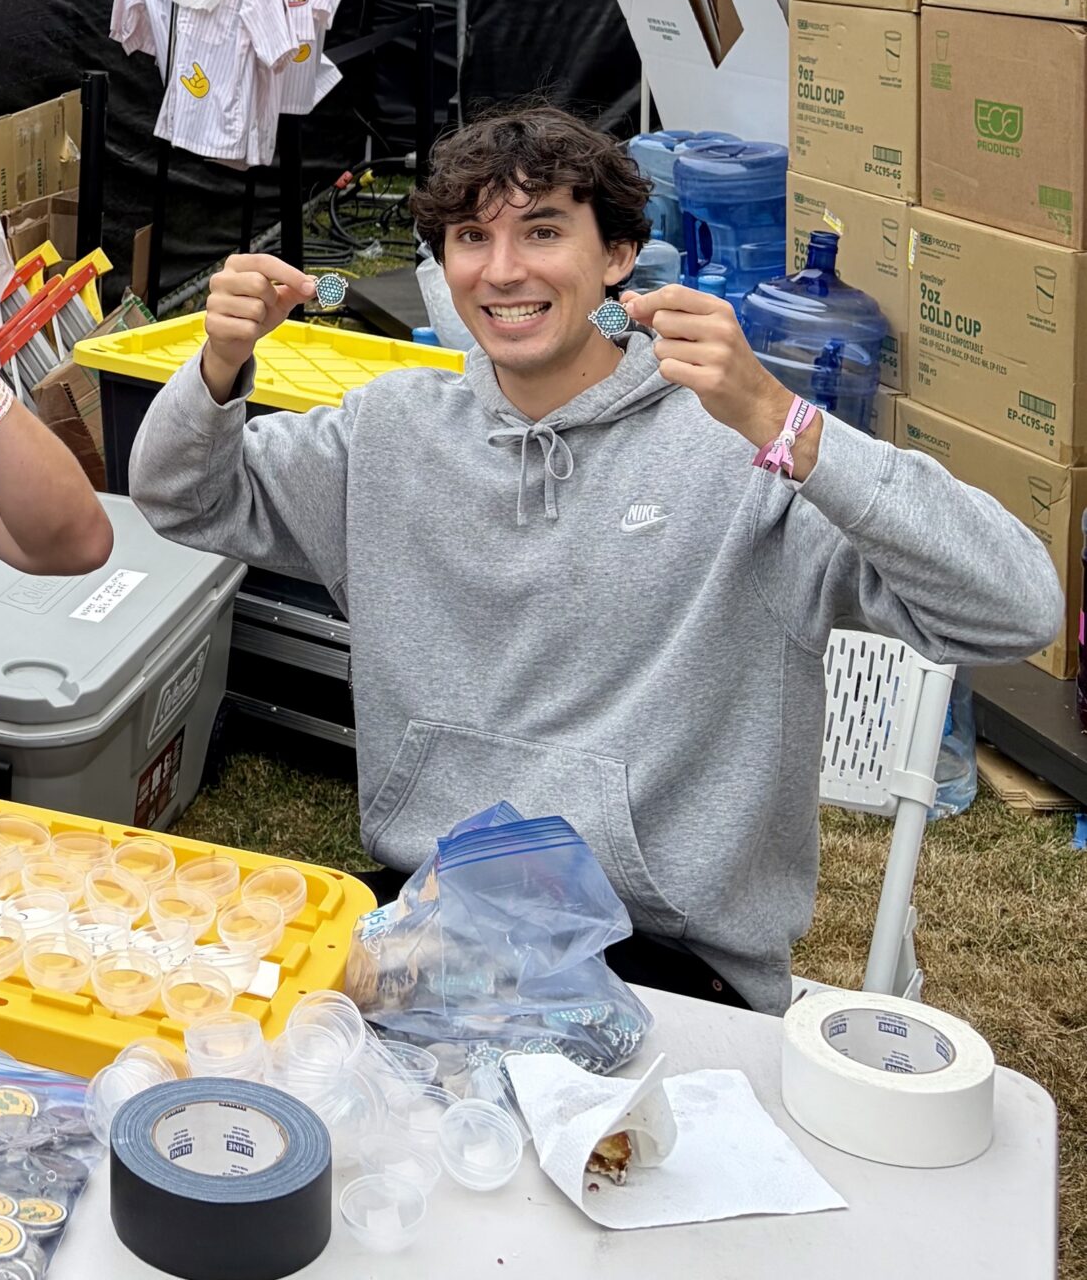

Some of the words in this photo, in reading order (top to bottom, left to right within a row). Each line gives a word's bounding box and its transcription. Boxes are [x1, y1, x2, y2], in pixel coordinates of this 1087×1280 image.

[798, 64, 815, 82] 9oz
[798, 82, 822, 101] COLD
[824, 88, 845, 106] CUP
[977, 103, 1021, 140] ECO
[977, 140, 1021, 158] PRODUCTS
[933, 237, 961, 252] PRODUCTS
[921, 282, 941, 305] 9oz
[921, 302, 952, 328] COLD
[956, 314, 982, 338] CUP
[920, 323, 945, 340] RENEWABLE
[950, 335, 984, 354] COMPOSTABLE
[1008, 407, 1055, 436] EP-CC9S-GS
[627, 504, 661, 520] NIKE
[878, 1022, 907, 1038] ULINE
[170, 1143, 192, 1160] ULINE
[226, 1140, 254, 1158] ULINE
